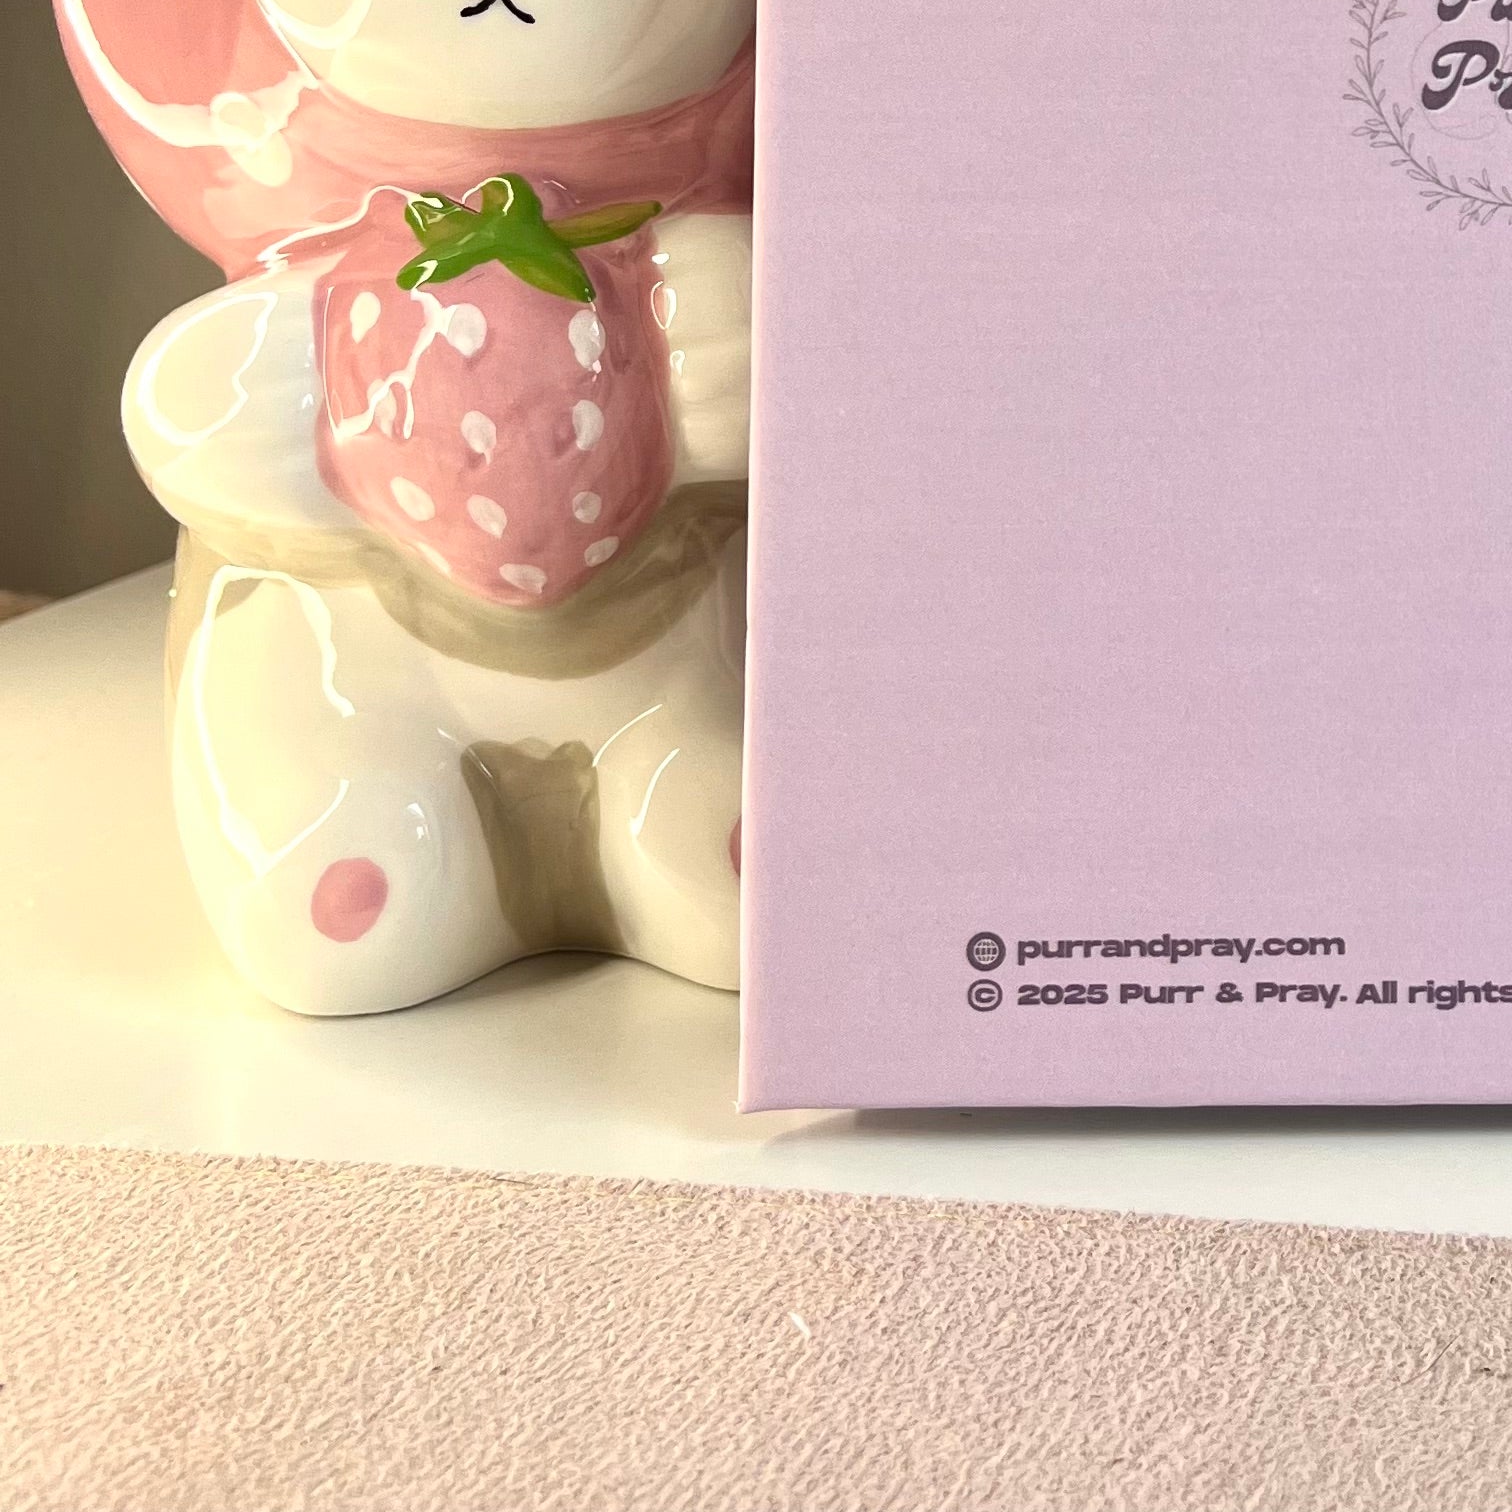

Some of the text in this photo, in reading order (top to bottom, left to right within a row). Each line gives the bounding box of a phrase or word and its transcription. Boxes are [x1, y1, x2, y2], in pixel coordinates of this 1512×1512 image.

[1016, 932, 1346, 965] purrandpray.com
[1017, 982, 1109, 1006] 2025
[1119, 982, 1204, 1004] Purr
[1215, 981, 1244, 1004] &
[1255, 981, 1348, 1009] Pray.
[1356, 980, 1398, 1005] All
